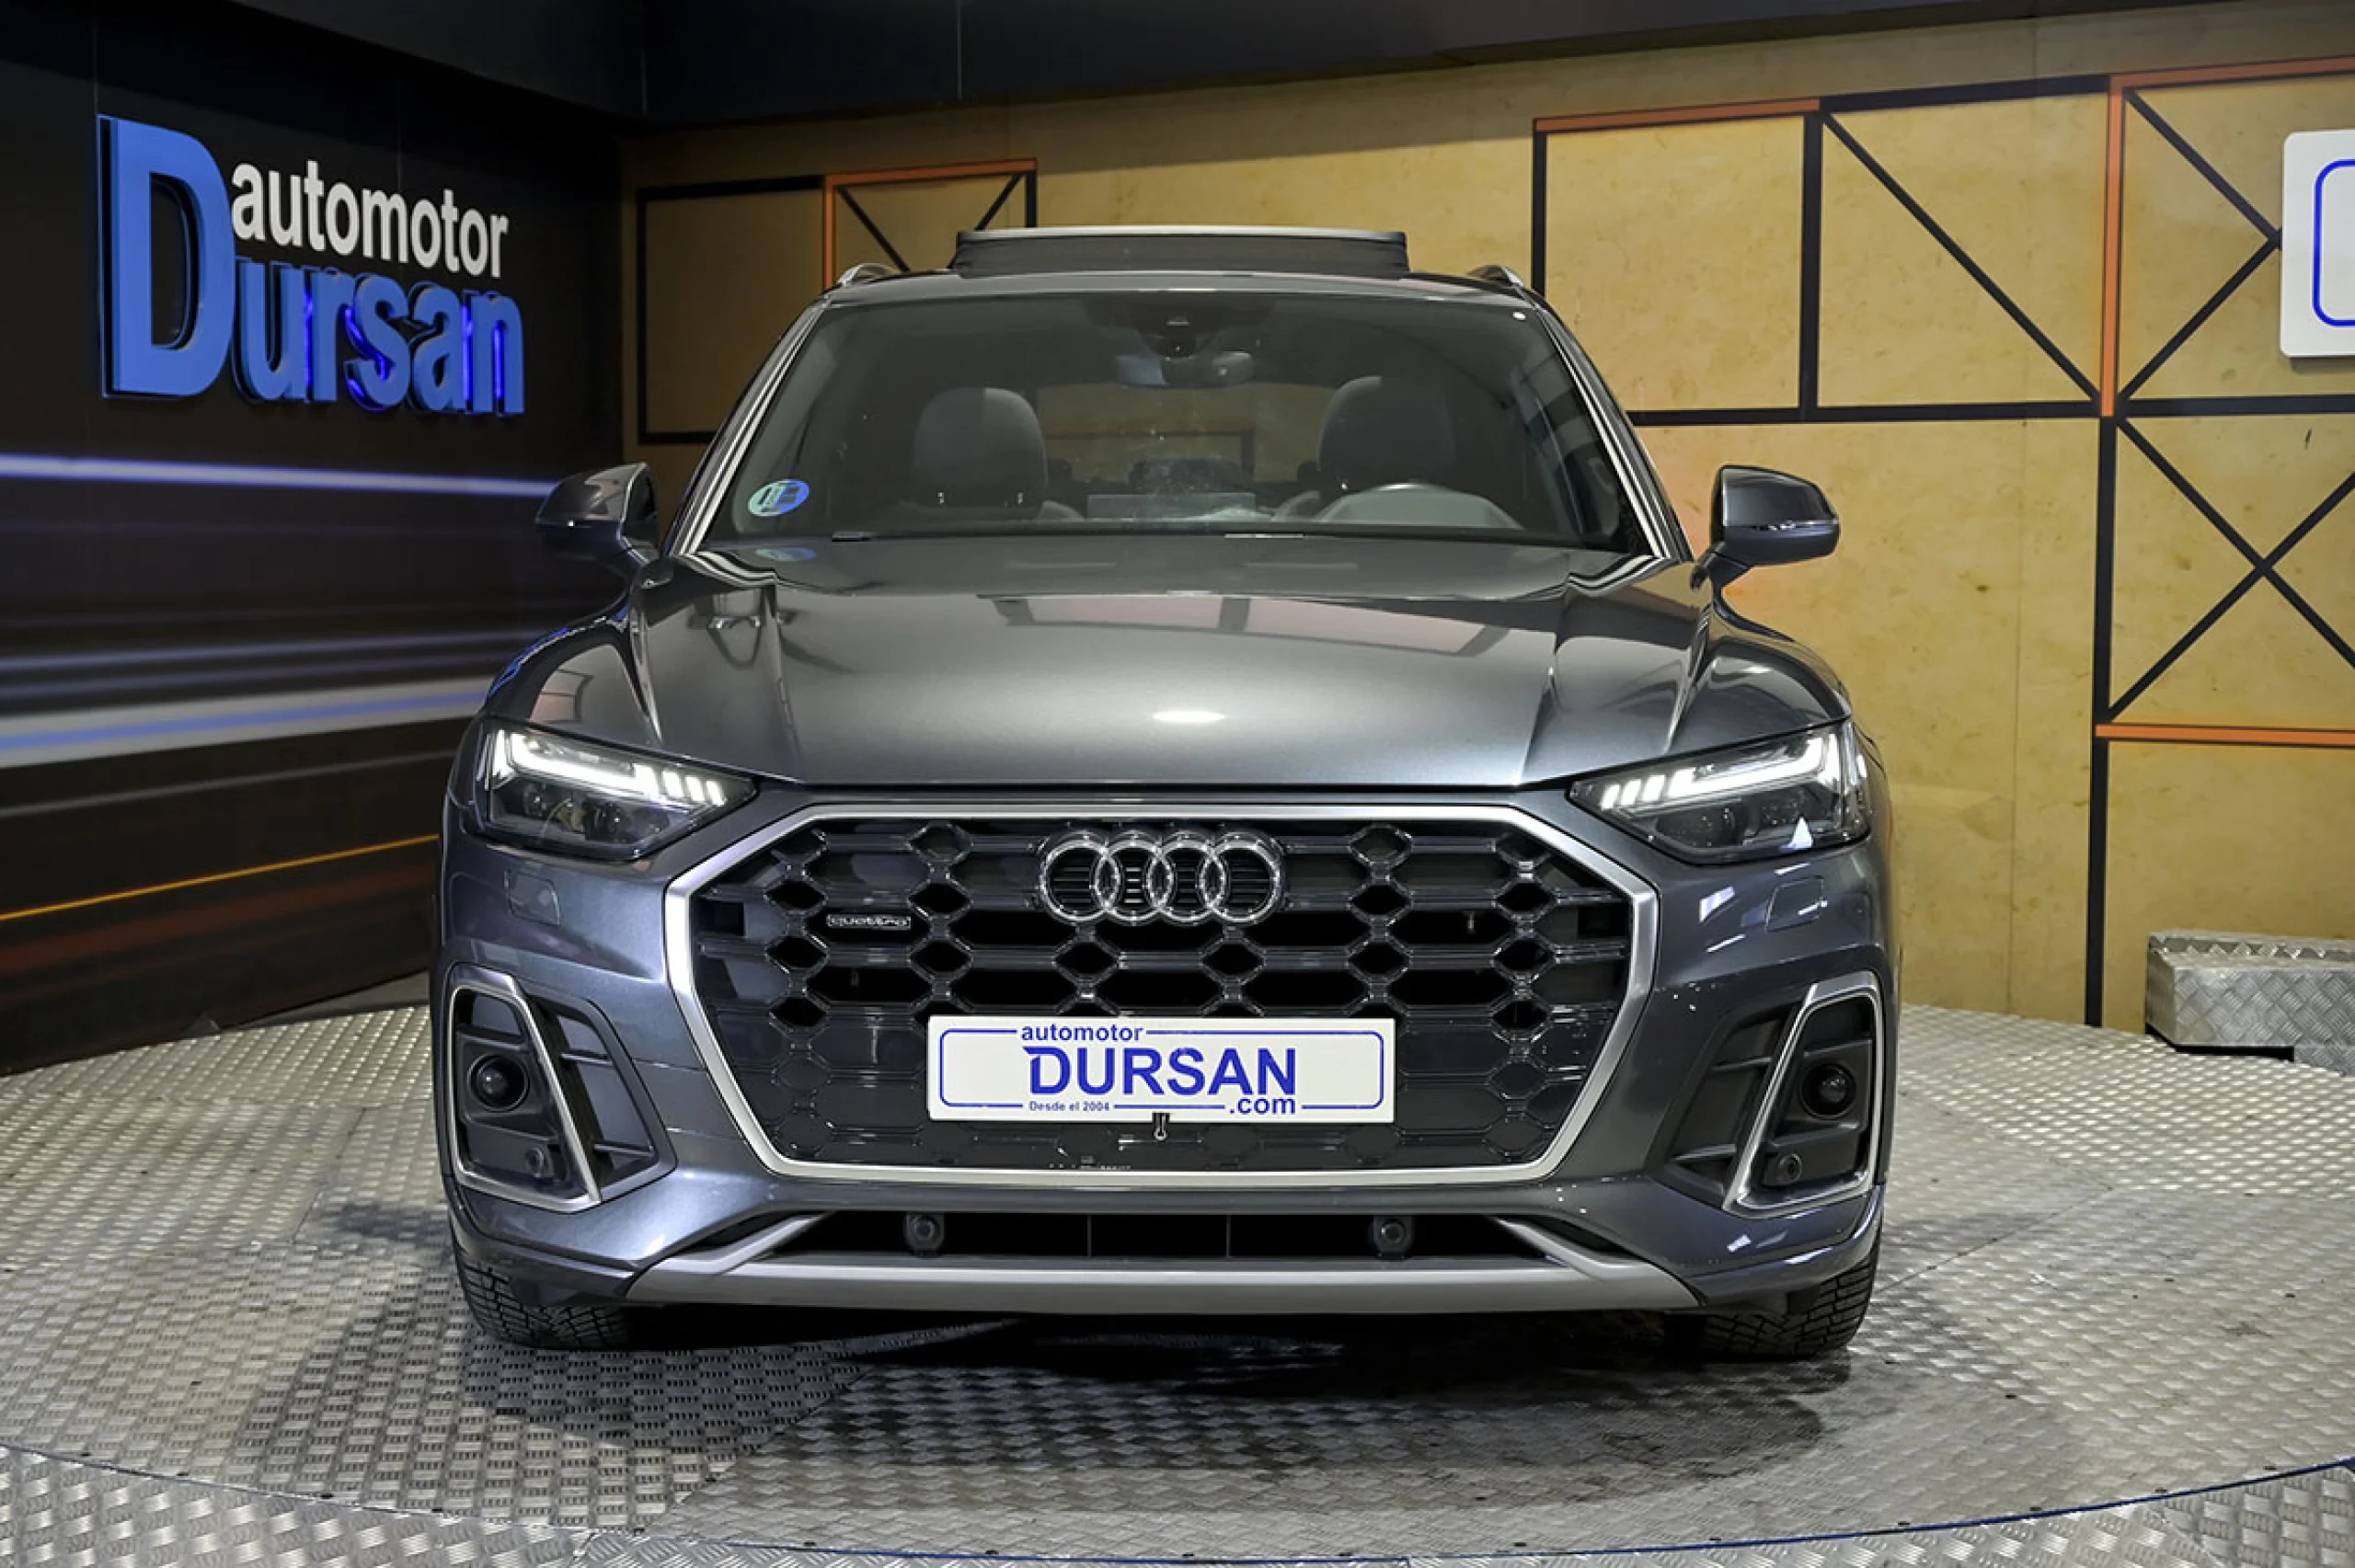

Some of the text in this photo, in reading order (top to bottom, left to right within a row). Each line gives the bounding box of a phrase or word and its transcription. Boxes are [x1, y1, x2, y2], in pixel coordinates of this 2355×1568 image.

[232, 160, 509, 278] automotor
[97, 113, 524, 415] Dursan
[1021, 1024, 1143, 1041] automotor
[1022, 1046, 1296, 1095] DURSAN
[1029, 1101, 1109, 1111] Desde el 2004
[1229, 1096, 1296, 1115] .com
